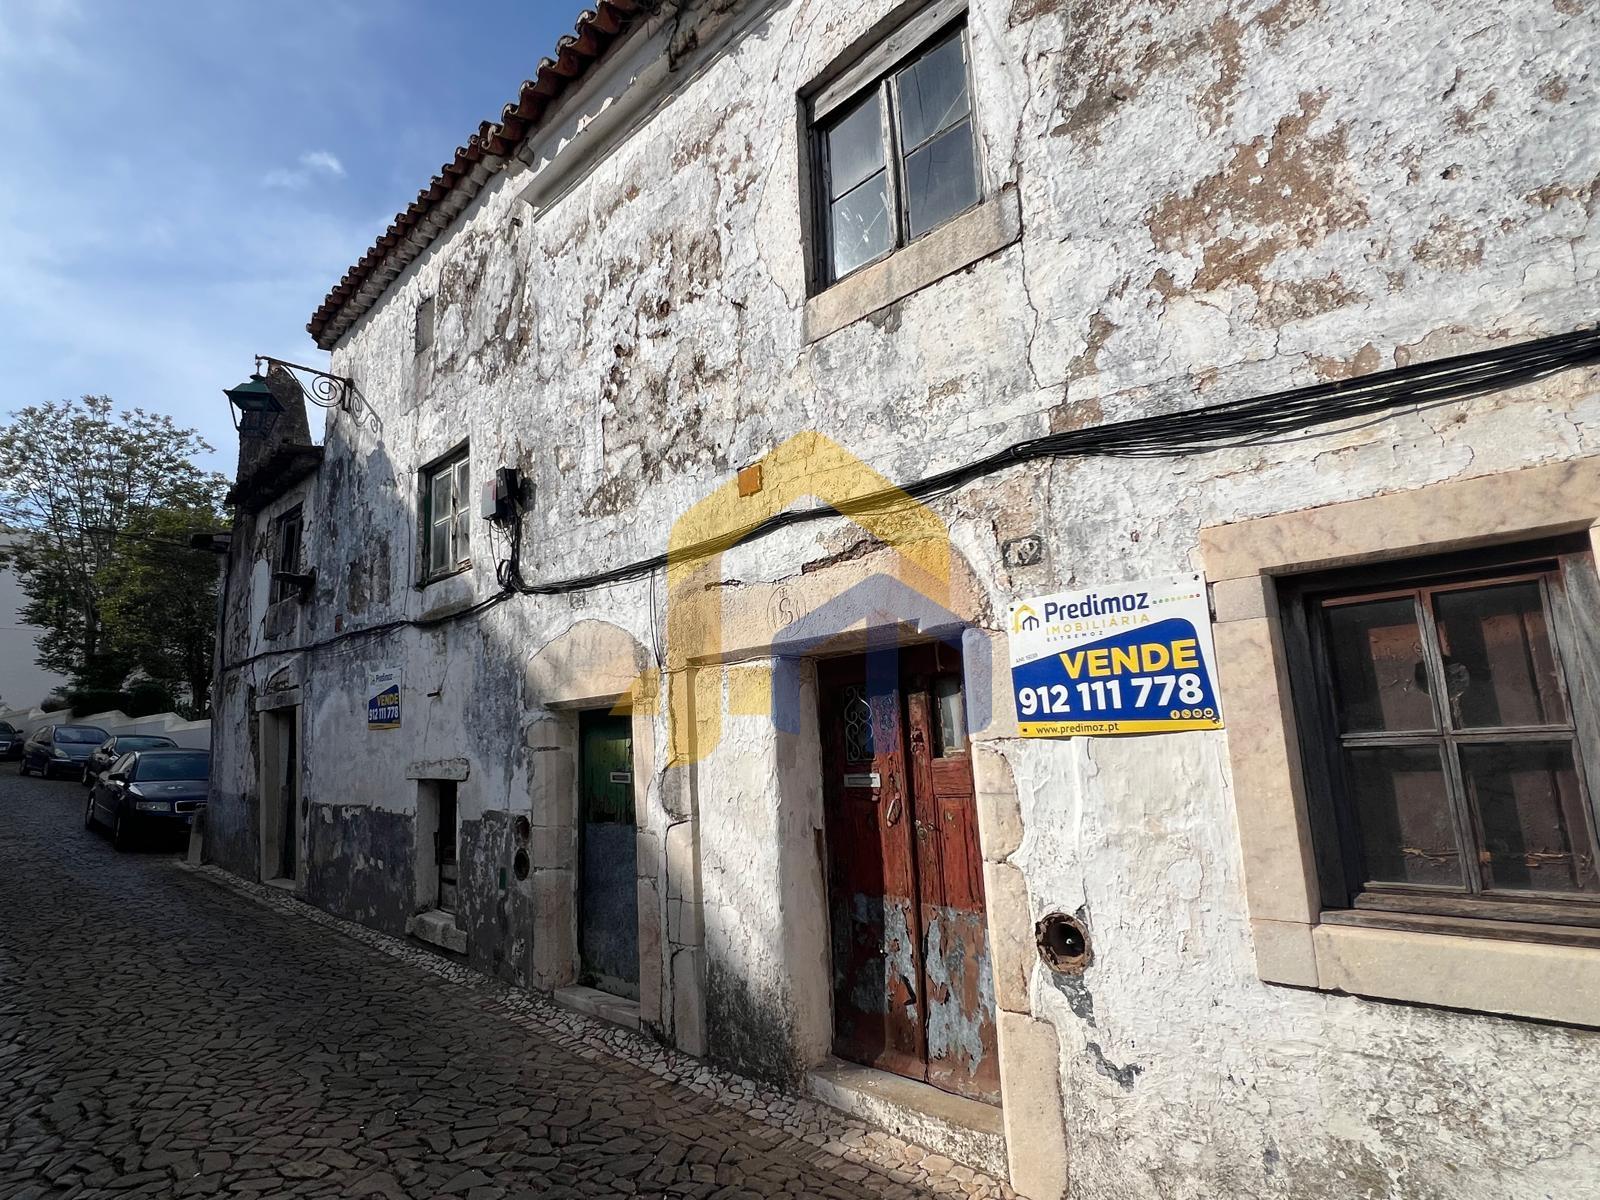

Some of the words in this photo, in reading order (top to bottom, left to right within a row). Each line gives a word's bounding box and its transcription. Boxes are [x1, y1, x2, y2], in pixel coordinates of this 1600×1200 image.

[1044, 592, 1150, 622] Predimoz
[1046, 613, 1151, 635] IMOBILIÁRIA
[1059, 639, 1199, 679] VENDE
[377, 694, 398, 706] VENDE
[1018, 684, 1071, 715] 912
[1076, 678, 1122, 711] 111
[1131, 673, 1204, 707] 778
[369, 709, 378, 720] 912
[387, 706, 398, 718] 778
[1035, 722, 1120, 734] www.predimoz.pt
